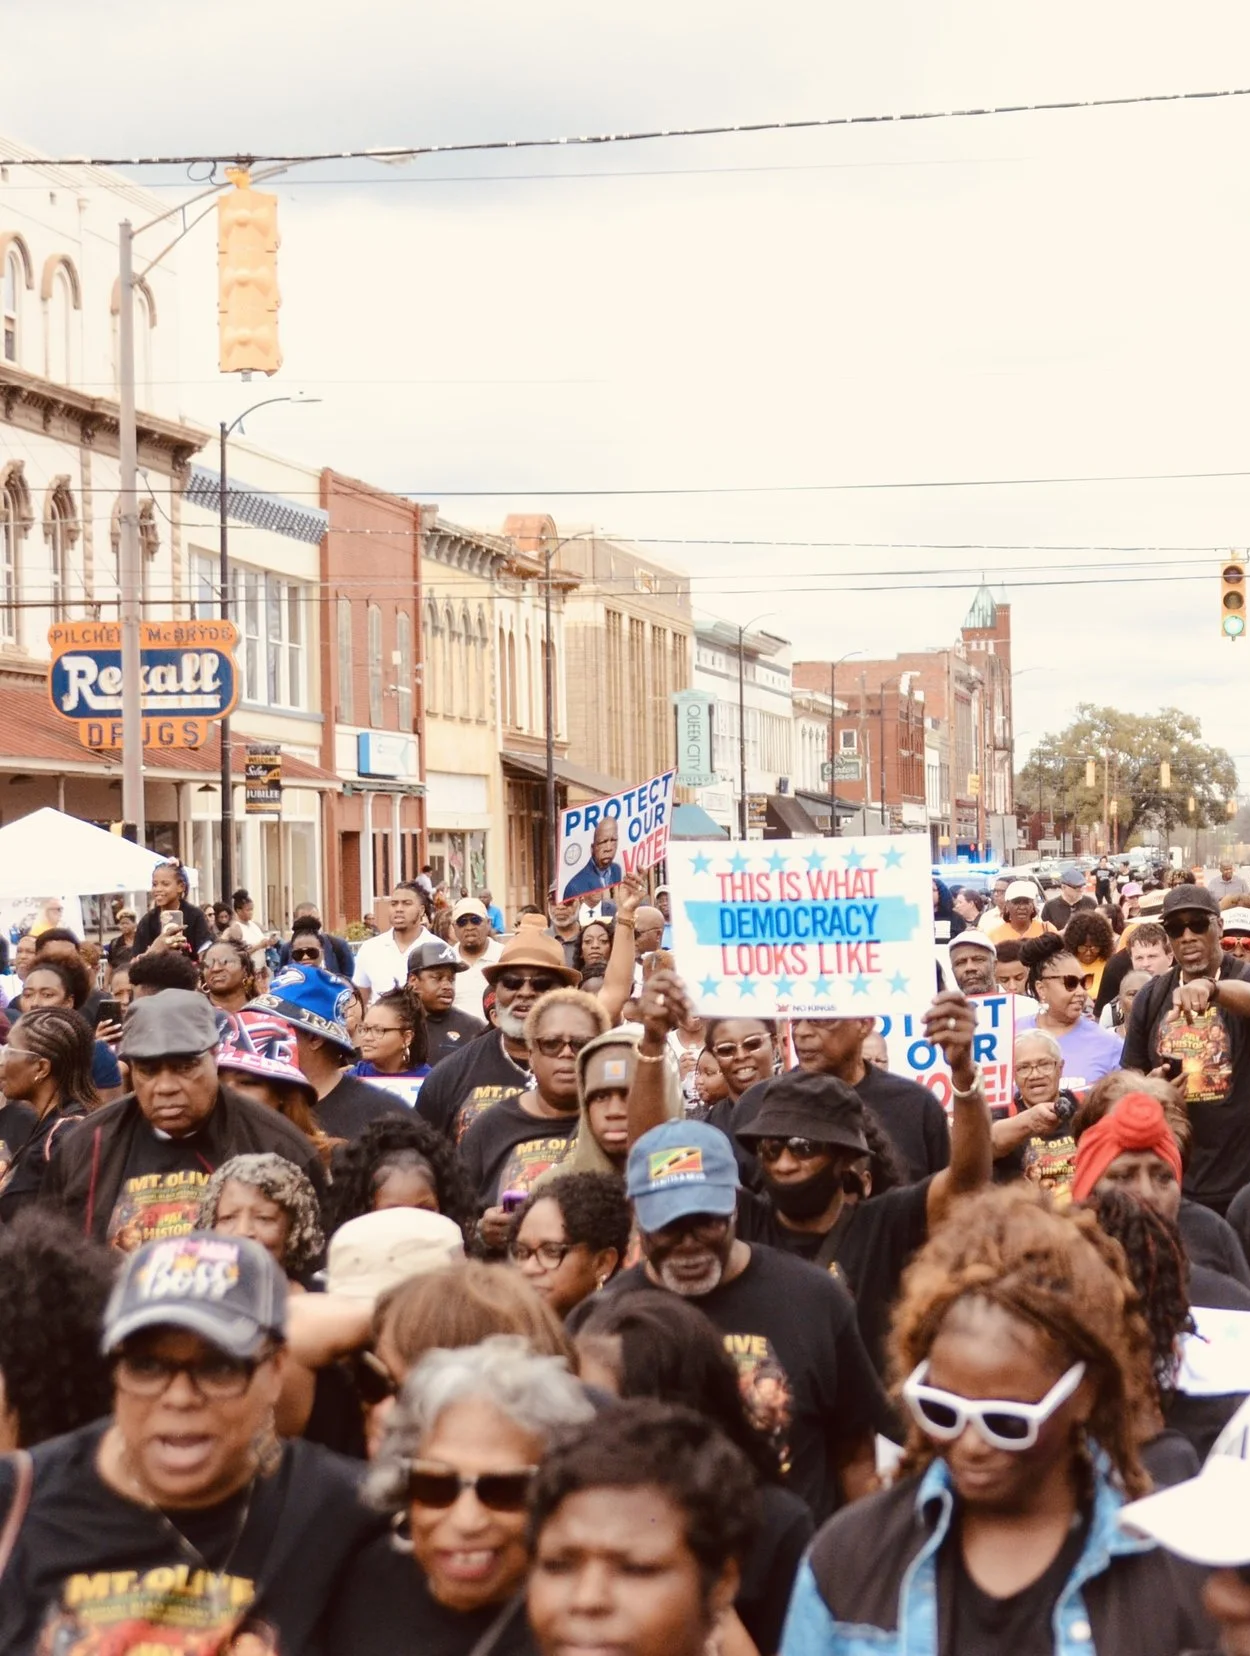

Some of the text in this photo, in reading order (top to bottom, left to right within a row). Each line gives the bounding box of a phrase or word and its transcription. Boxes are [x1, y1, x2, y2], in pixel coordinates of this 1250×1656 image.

[53, 627, 233, 644] PILCHE McBRYDE
[687, 704, 701, 742] QUEEN
[687, 744, 701, 772] CITY
[565, 772, 673, 837] PROTECT
[628, 802, 666, 843] OUR
[622, 825, 668, 874] VOTE!
[716, 868, 879, 903] THIS IS WHAT
[719, 903, 880, 939] DEMOCRACY
[721, 939, 883, 976] LOOKS LIKE
[907, 1033, 998, 1071] OR
[473, 1085, 503, 1099] MT.
[516, 1140, 546, 1155] MT.
[1048, 1135, 1075, 1149] OLIV
[128, 1170, 210, 1193] MT. OLIV
[143, 1223, 193, 1240] HISTOR
[723, 1334, 768, 1358] IVE
[64, 1564, 255, 1607] MT. OLIVE
